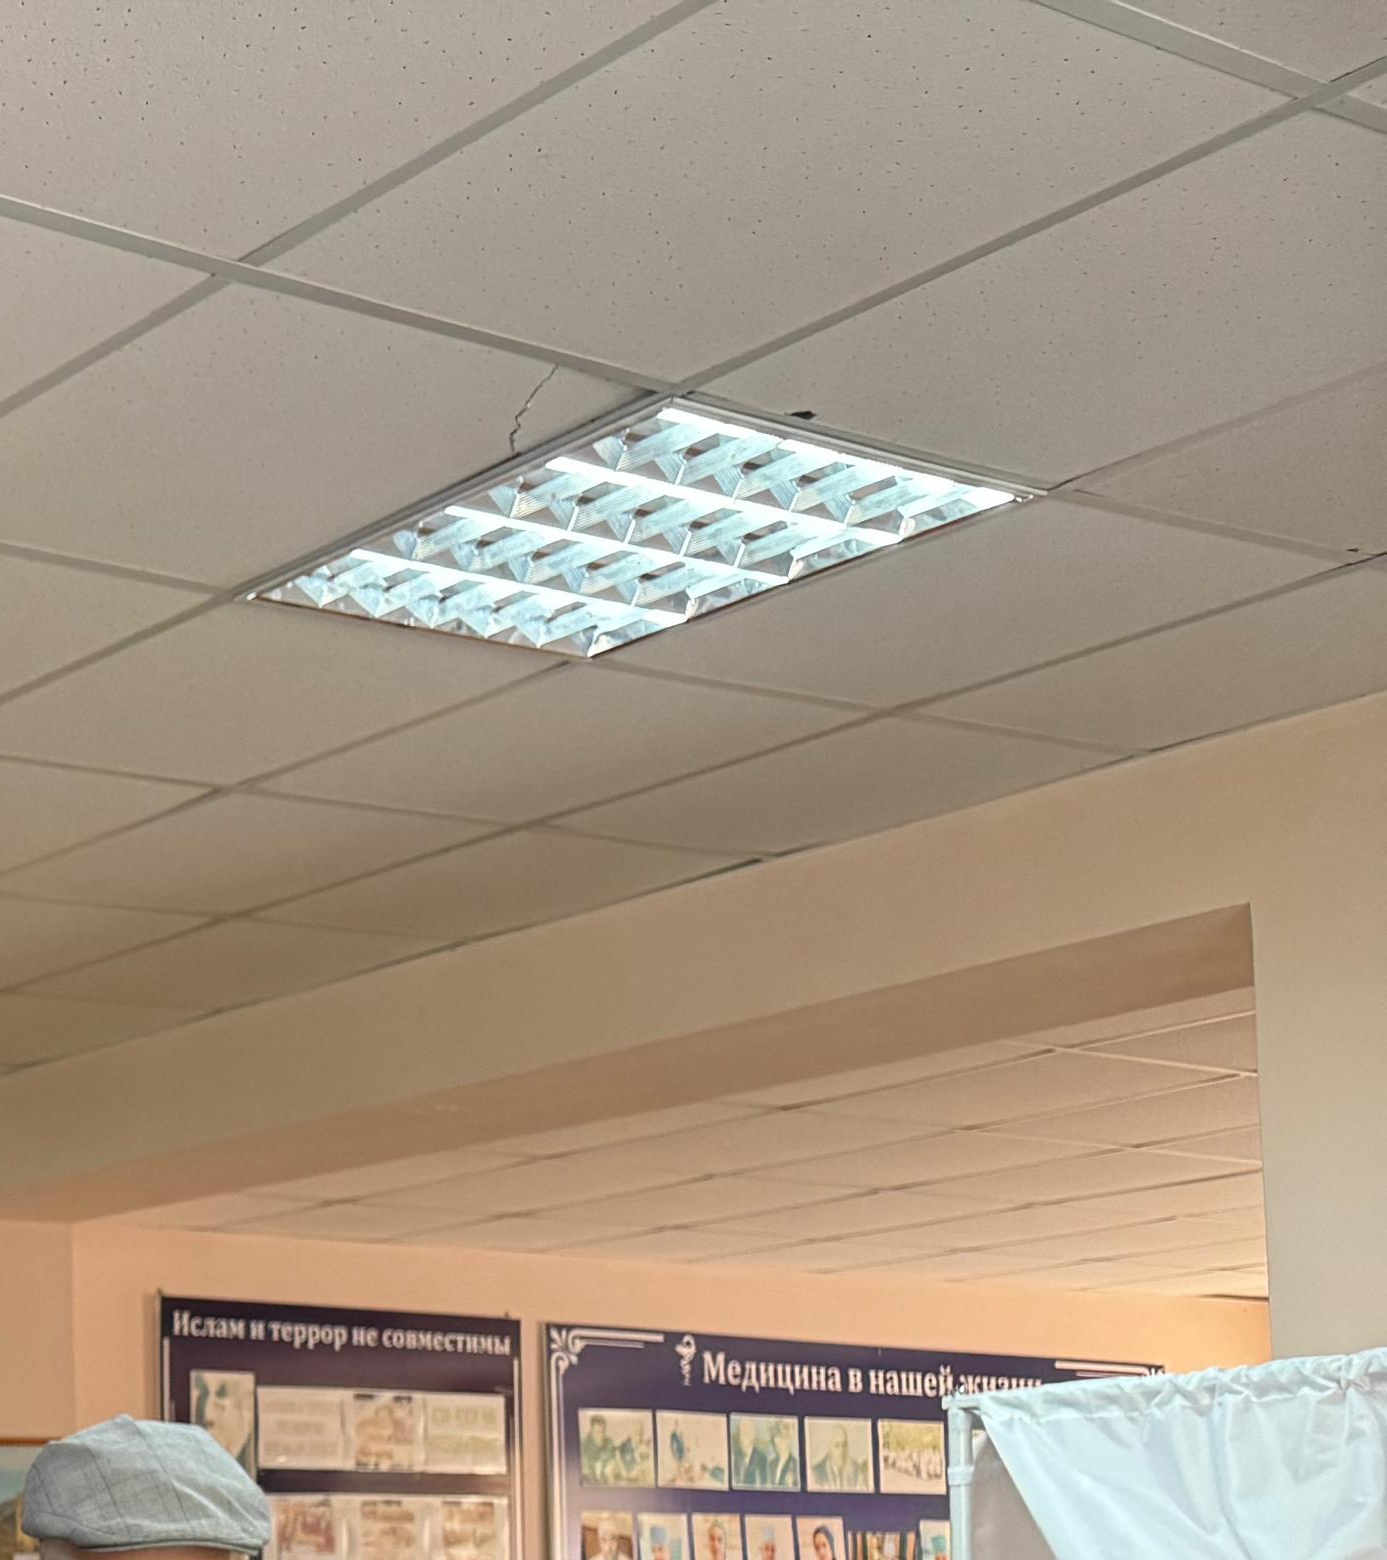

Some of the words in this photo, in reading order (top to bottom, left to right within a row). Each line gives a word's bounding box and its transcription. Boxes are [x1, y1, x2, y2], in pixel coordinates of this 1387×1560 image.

[172, 1309, 246, 1340] Ислам
[249, 1320, 265, 1341] и
[269, 1319, 349, 1351] террор
[352, 1327, 379, 1348] не
[382, 1328, 511, 1356] совместимы
[703, 1350, 843, 1396] Медицина
[848, 1372, 863, 1393] в
[869, 1364, 954, 1397] нашей
